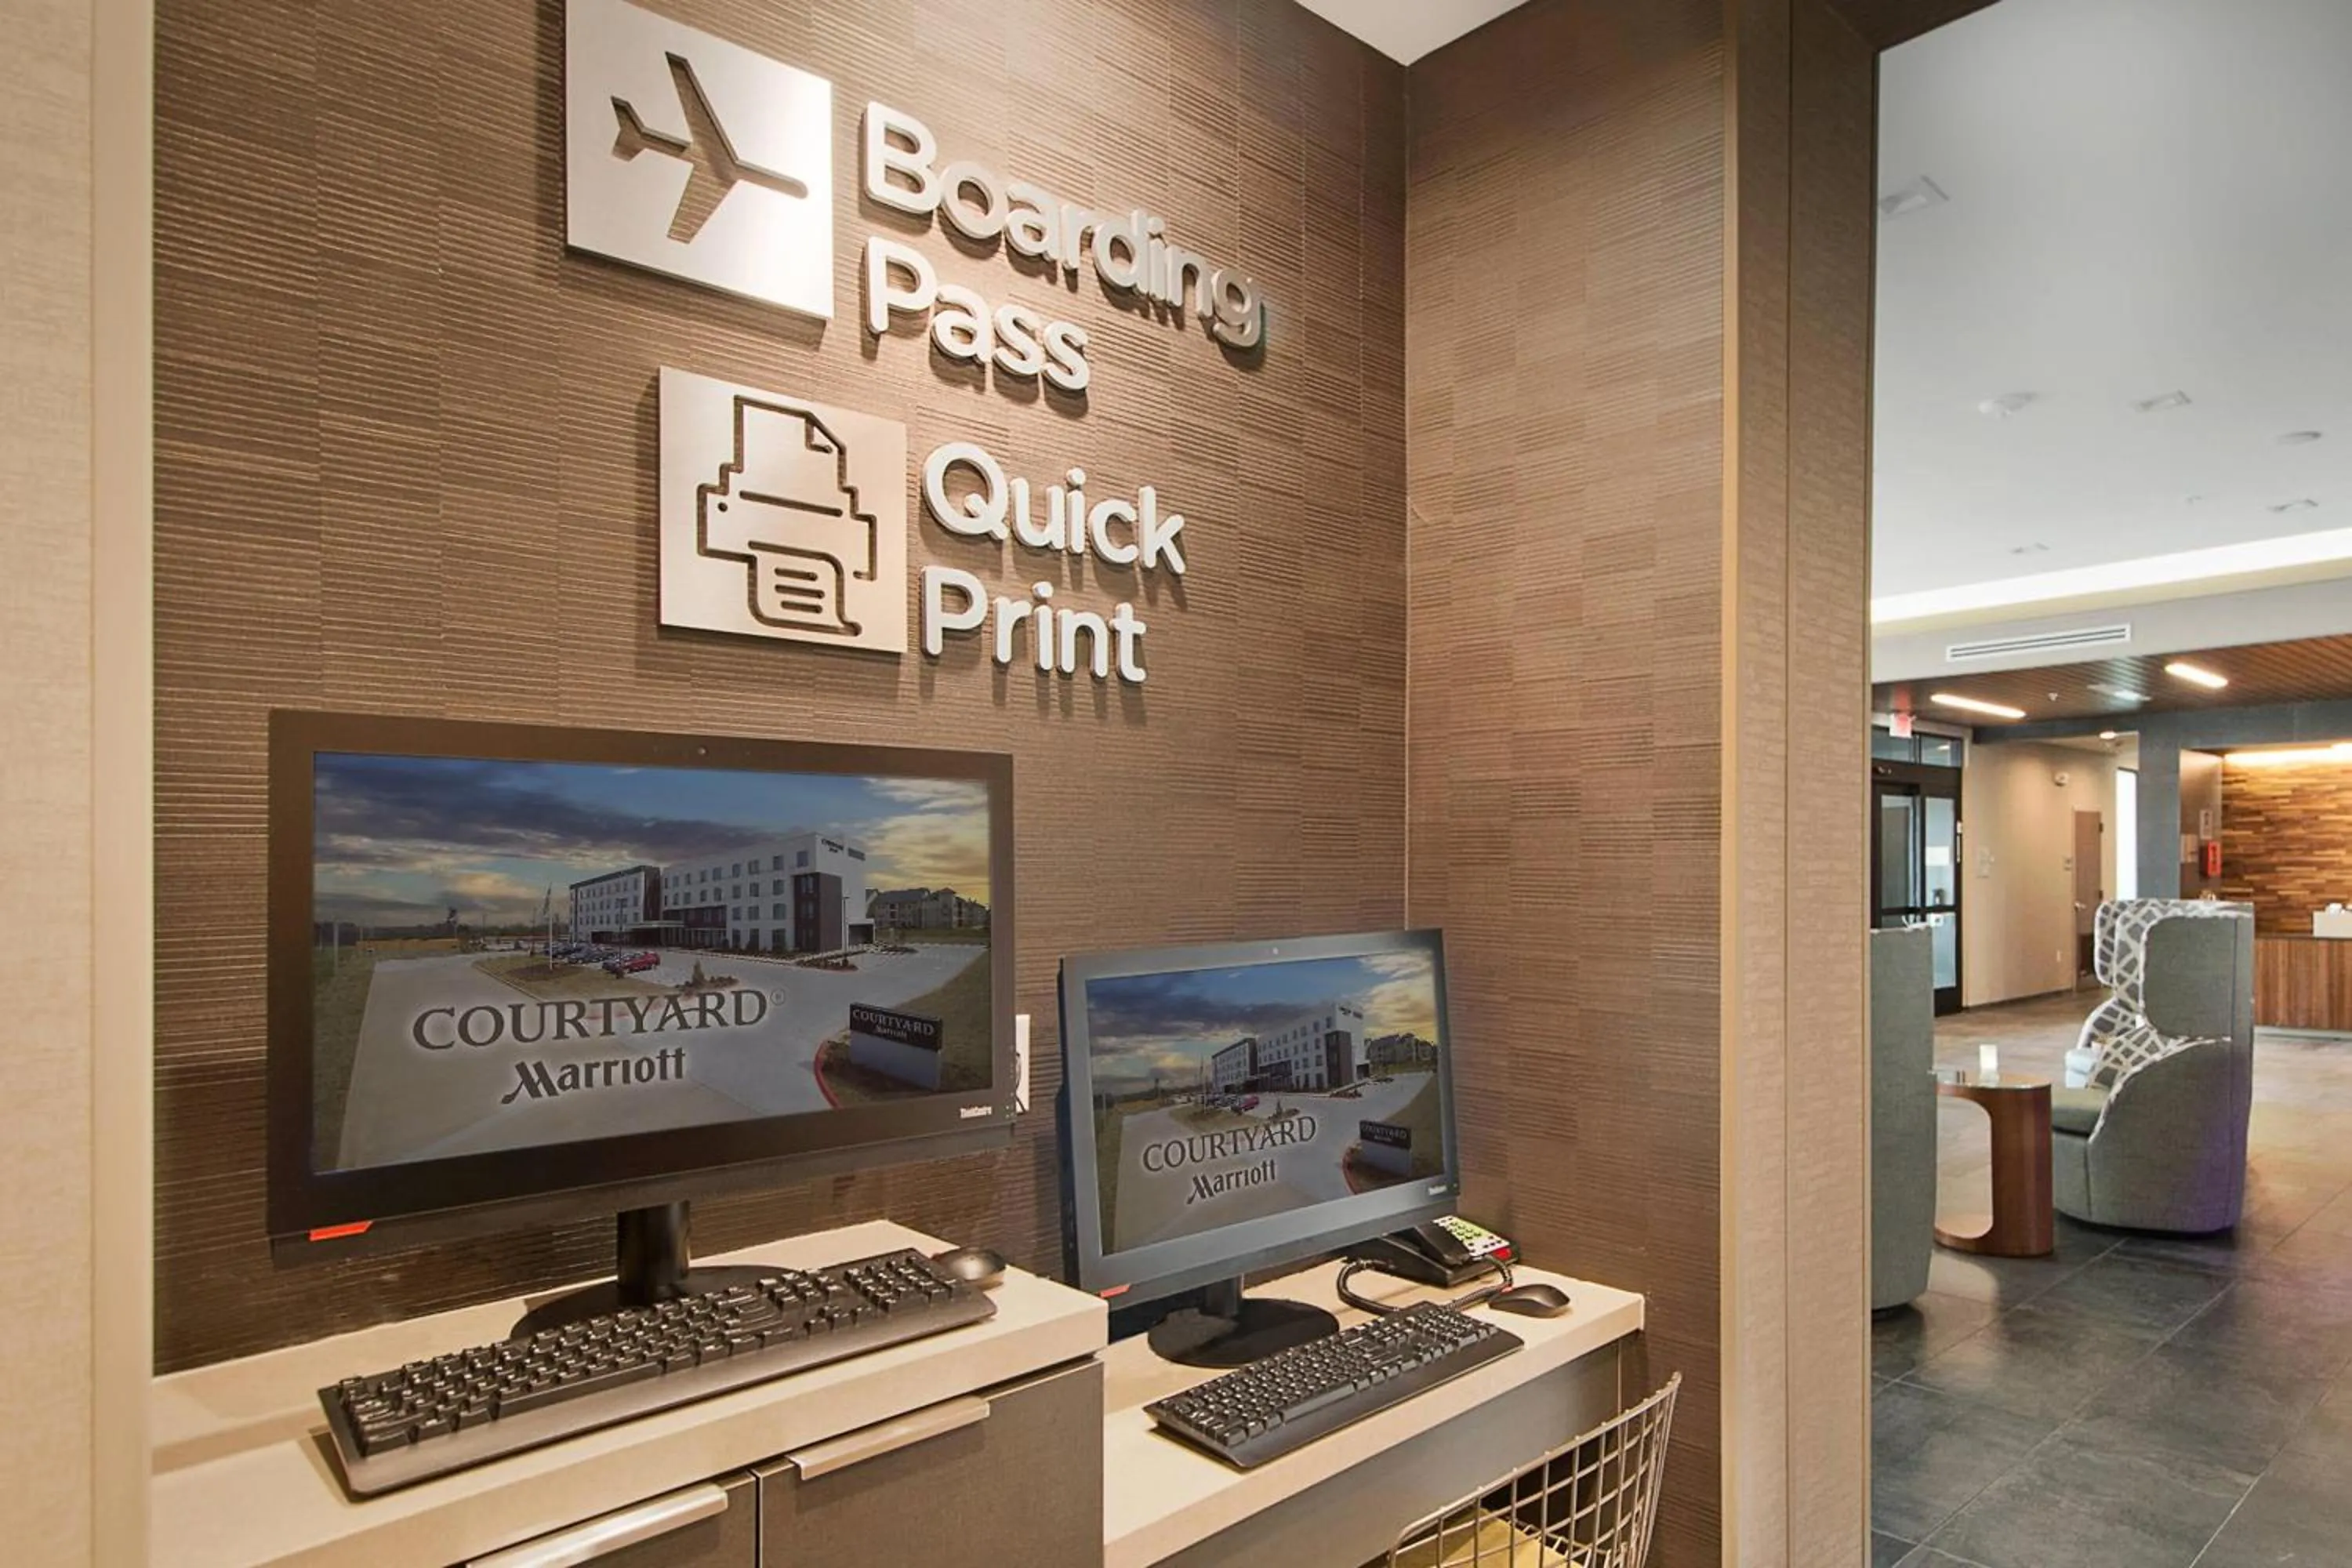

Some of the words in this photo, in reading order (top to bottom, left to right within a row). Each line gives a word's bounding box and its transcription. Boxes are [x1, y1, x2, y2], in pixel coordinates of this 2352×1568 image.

[863, 100, 1265, 348] Boarding
[864, 235, 1090, 391] Pass
[923, 441, 1185, 575] Quick
[921, 564, 1147, 683] Print
[412, 989, 768, 1051] COURTYARD
[852, 1008, 935, 1036] COURTYARD
[501, 1047, 686, 1105] Marriott
[1142, 1116, 1316, 1172] COURTYARD
[1186, 1159, 1276, 1205] Marriott
